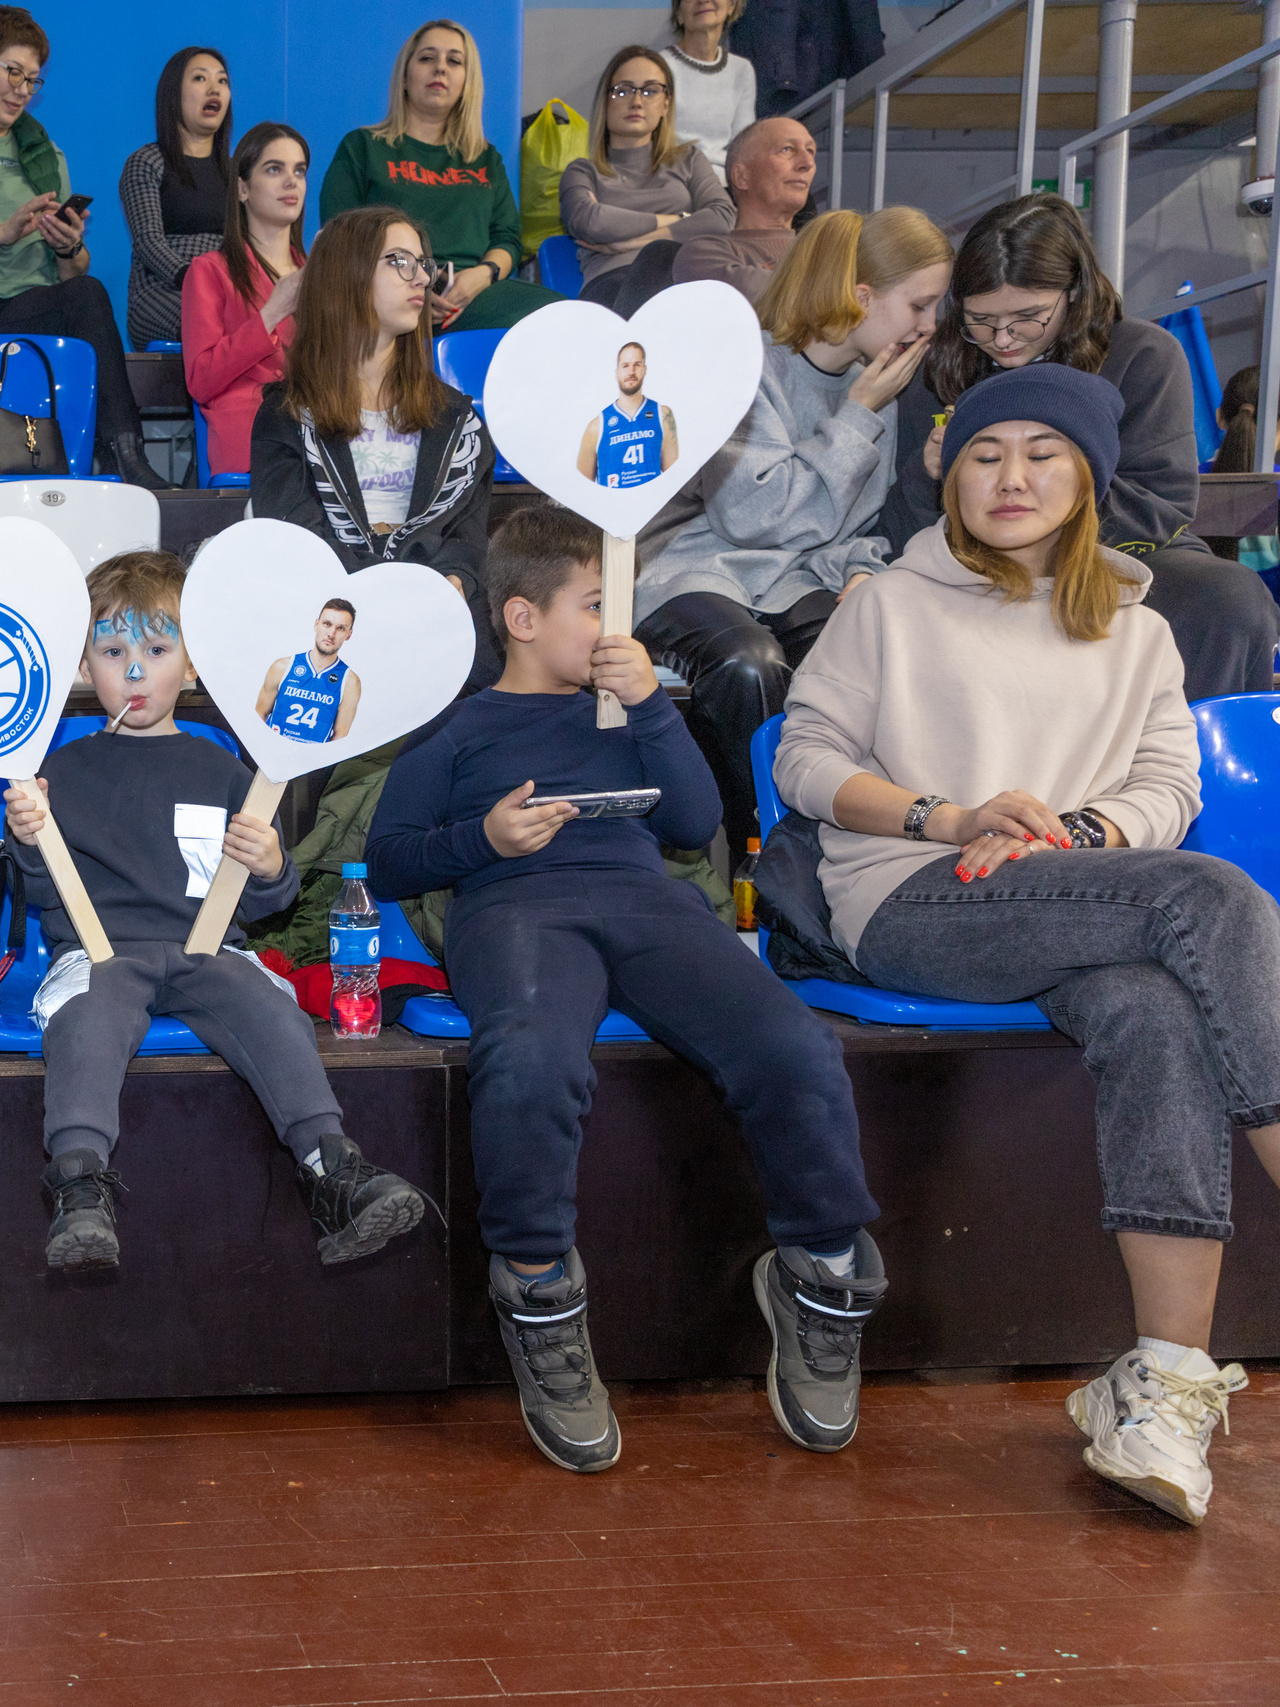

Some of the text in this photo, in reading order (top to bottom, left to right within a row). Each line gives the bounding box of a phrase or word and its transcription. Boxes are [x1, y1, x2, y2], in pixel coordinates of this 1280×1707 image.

[386, 160, 491, 187] HONEY
[608, 429, 656, 446] ДИНАМО
[622, 443, 646, 466] 41
[46, 493, 59, 503] 19
[283, 685, 335, 705] ДИНАМО
[285, 703, 320, 729] 24
